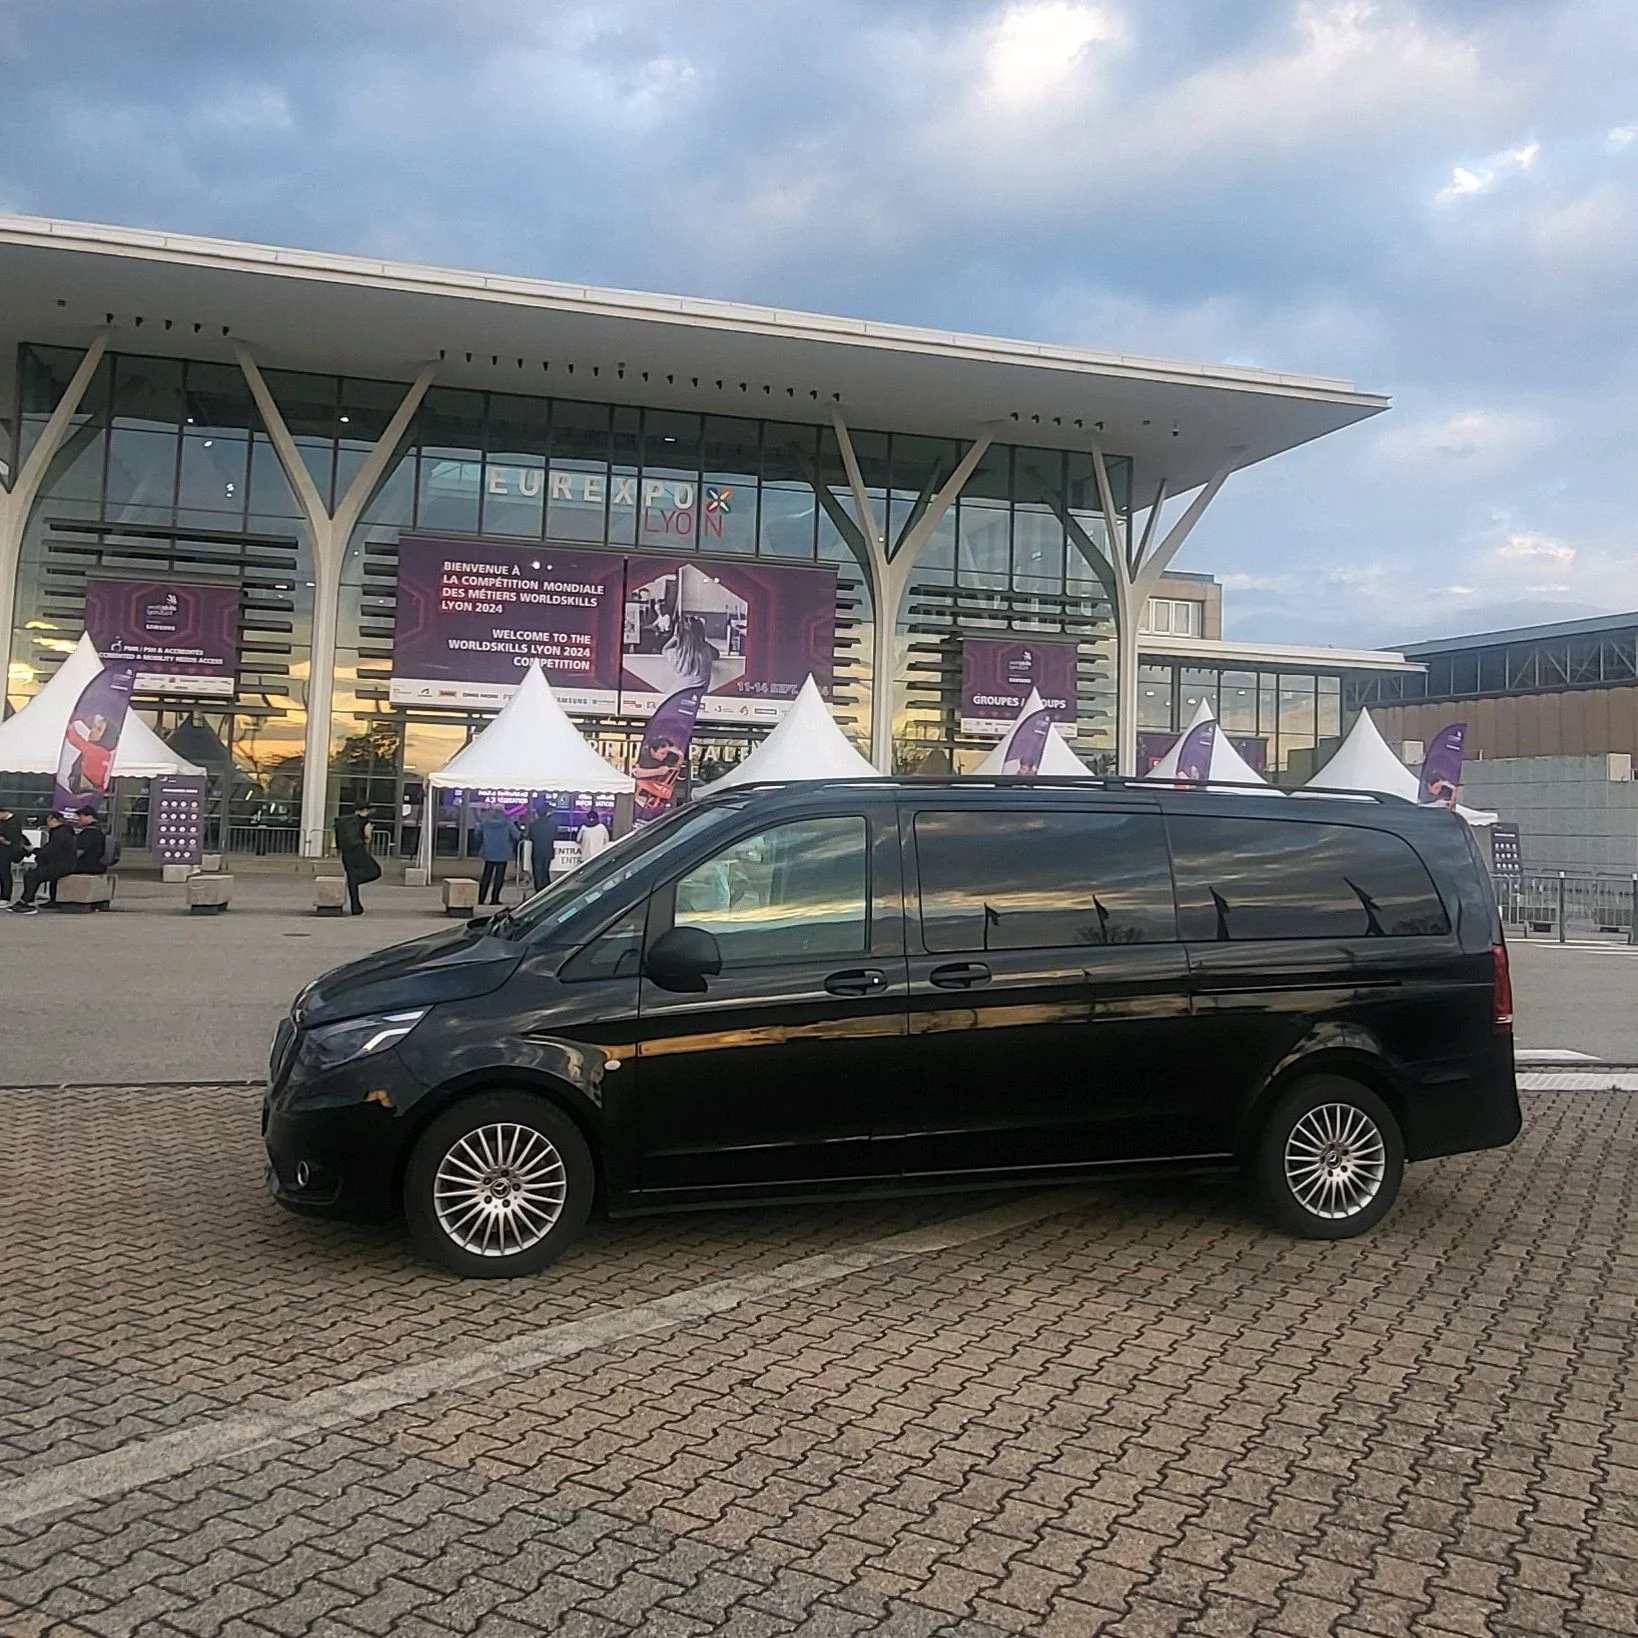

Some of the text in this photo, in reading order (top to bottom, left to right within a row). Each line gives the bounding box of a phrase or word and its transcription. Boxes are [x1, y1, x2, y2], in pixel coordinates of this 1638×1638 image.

[488, 465, 694, 510] EUREXPO
[643, 508, 724, 538] LYON
[443, 561, 510, 575] BIENVENUE
[443, 574, 605, 595] LA COMPÉTITION MONDIALE
[442, 587, 598, 608] DES MÉTIERS WORLDSKILLS
[441, 600, 503, 614] LYON 2024
[492, 628, 592, 645] WELCOME TO THE
[448, 639, 591, 658] WORLDSKILLS LYON 2024
[557, 696, 588, 705] AMSUNG
[972, 695, 1020, 707] GROUPES
[1040, 698, 1067, 709] OUPS
